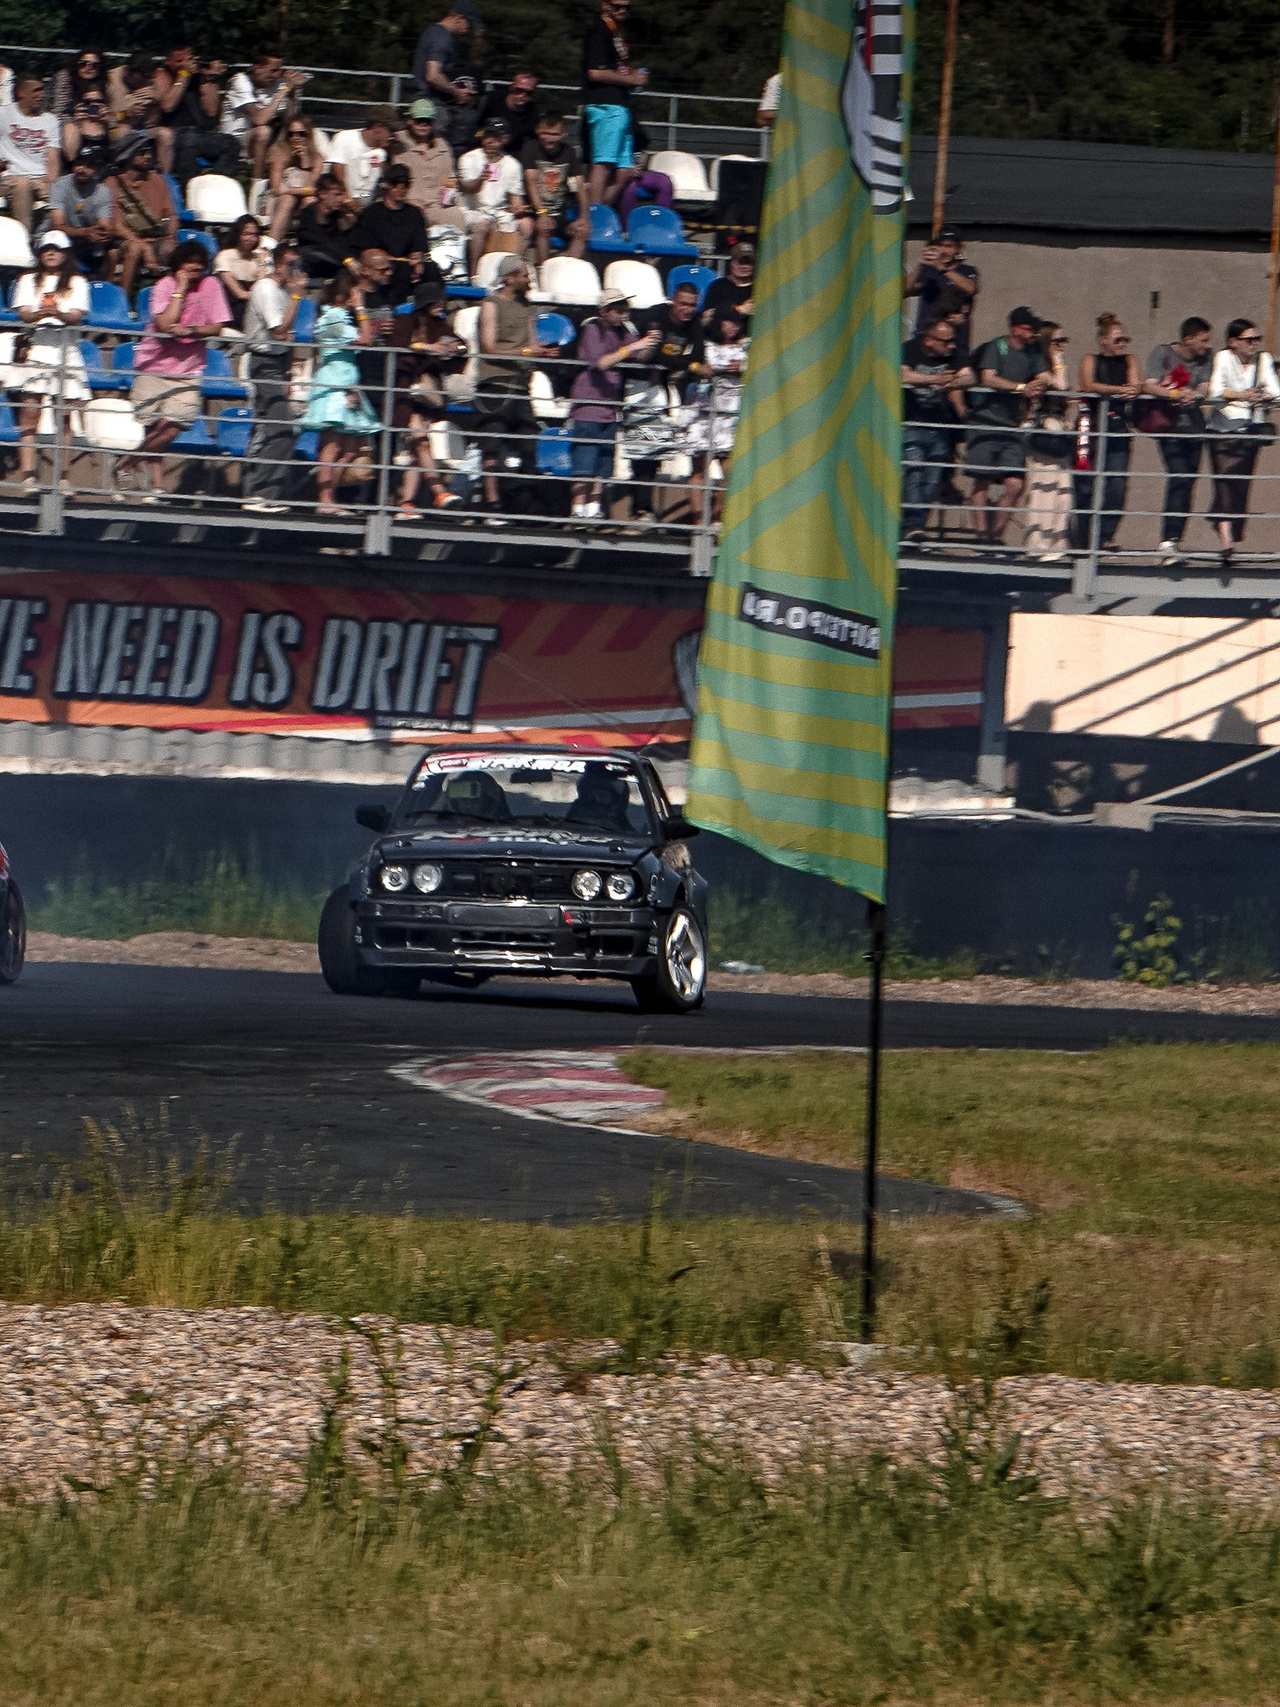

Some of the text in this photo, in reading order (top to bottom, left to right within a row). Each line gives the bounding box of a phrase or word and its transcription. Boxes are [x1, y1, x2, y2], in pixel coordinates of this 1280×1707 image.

[53, 602, 219, 701] NEED
[229, 611, 304, 709] IS
[310, 615, 498, 718] DRIFT
